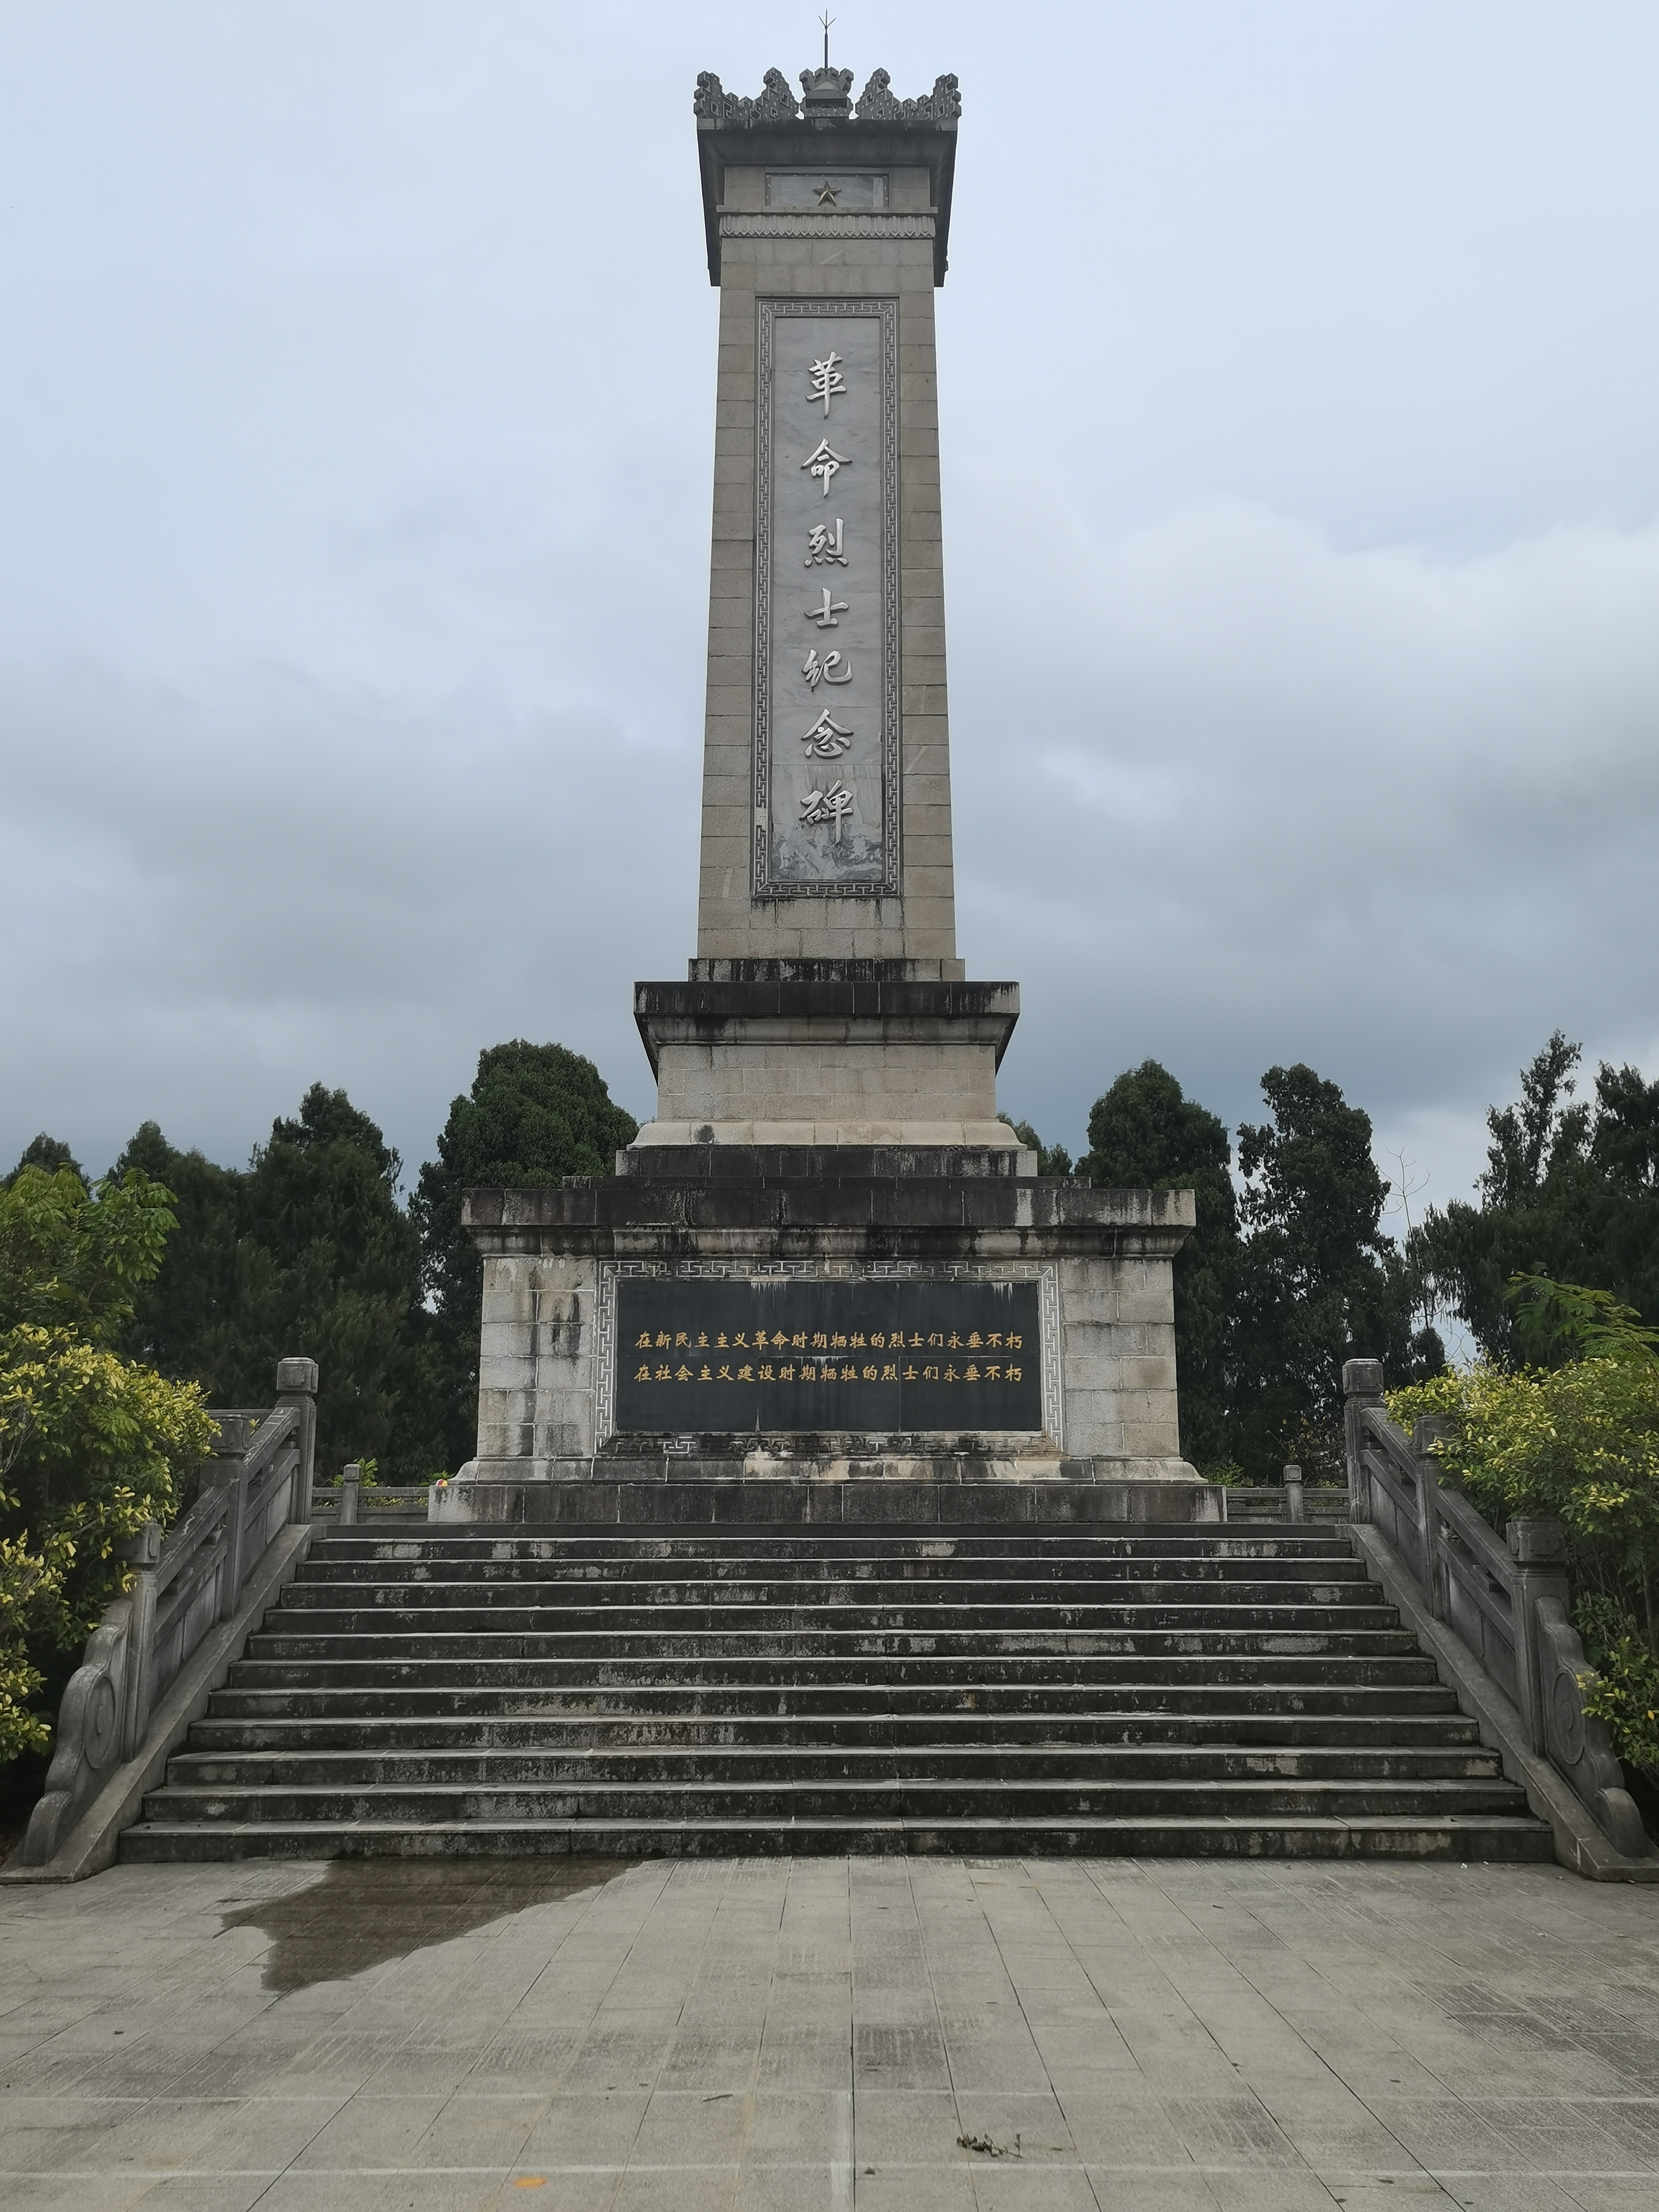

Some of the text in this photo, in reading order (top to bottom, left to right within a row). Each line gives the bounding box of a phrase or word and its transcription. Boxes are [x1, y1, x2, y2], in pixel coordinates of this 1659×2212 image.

[799, 351, 854, 845] 革命烈士纪念碑
[635, 1330, 1023, 1350] 在新民主主义革命时期牺牲的烈士们永垂不朽
[634, 1363, 1022, 1382] 在社会主义建设时期牺牲的烈士们永垂不朽
